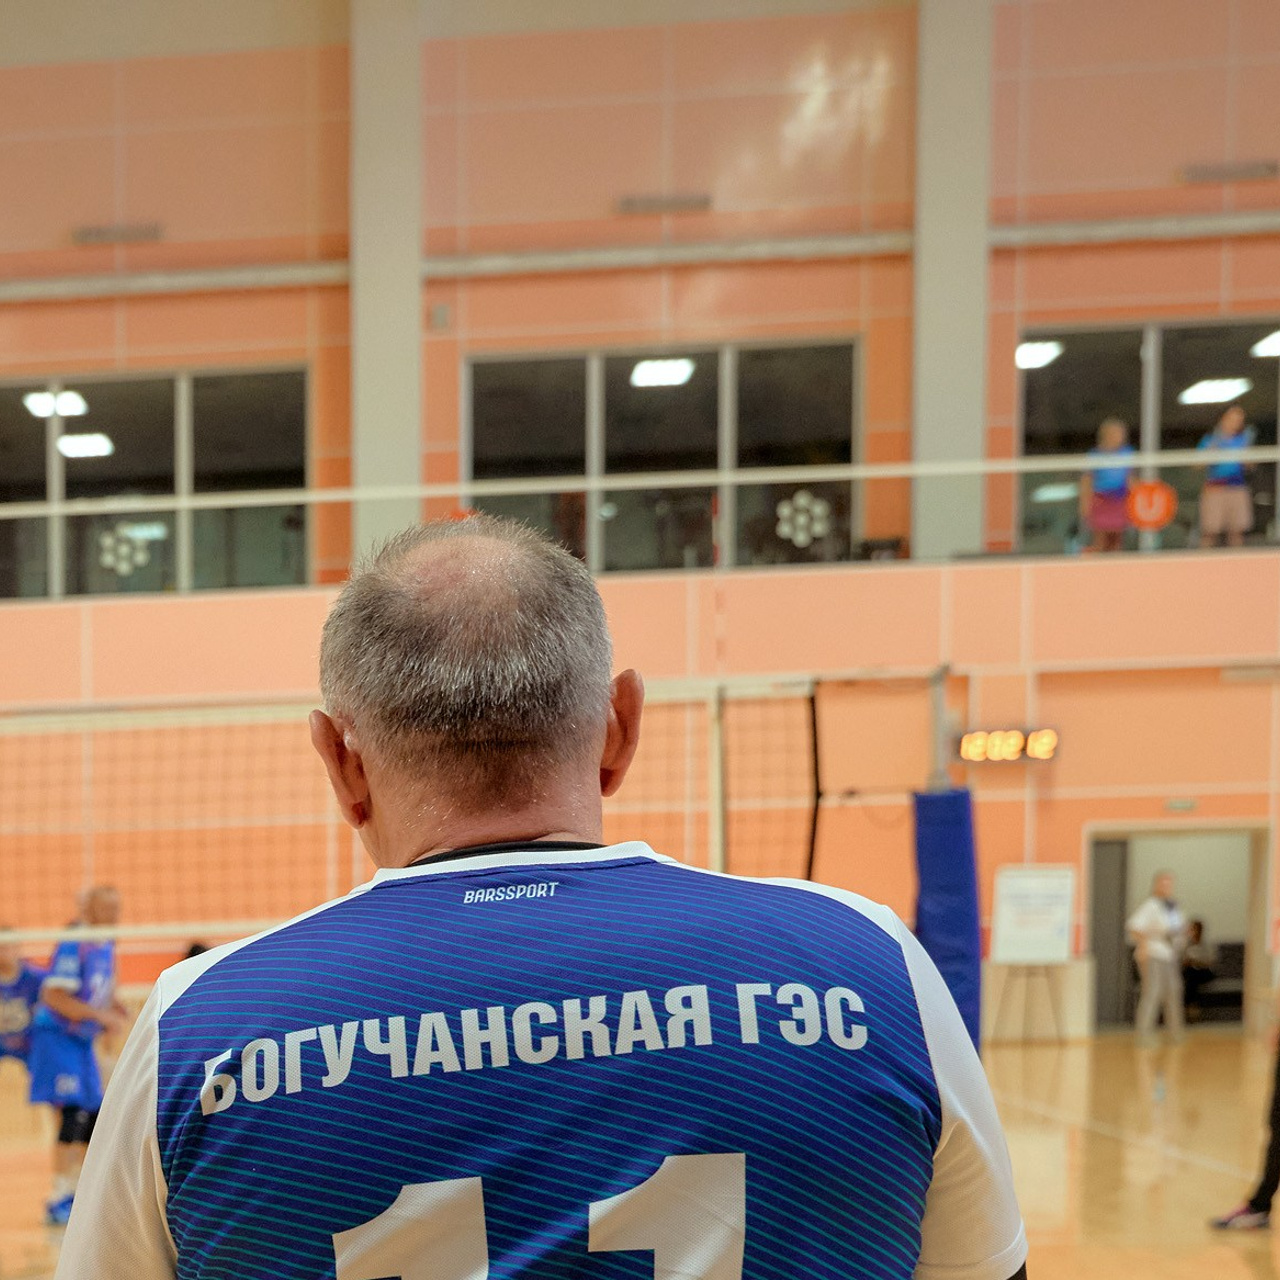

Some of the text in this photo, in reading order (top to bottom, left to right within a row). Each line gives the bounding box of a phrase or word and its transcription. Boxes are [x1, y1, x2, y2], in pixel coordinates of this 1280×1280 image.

[463, 881, 560, 904] BARSSPORT
[201, 981, 869, 1117] БОГУЧАНСКАЯ ГЭС
